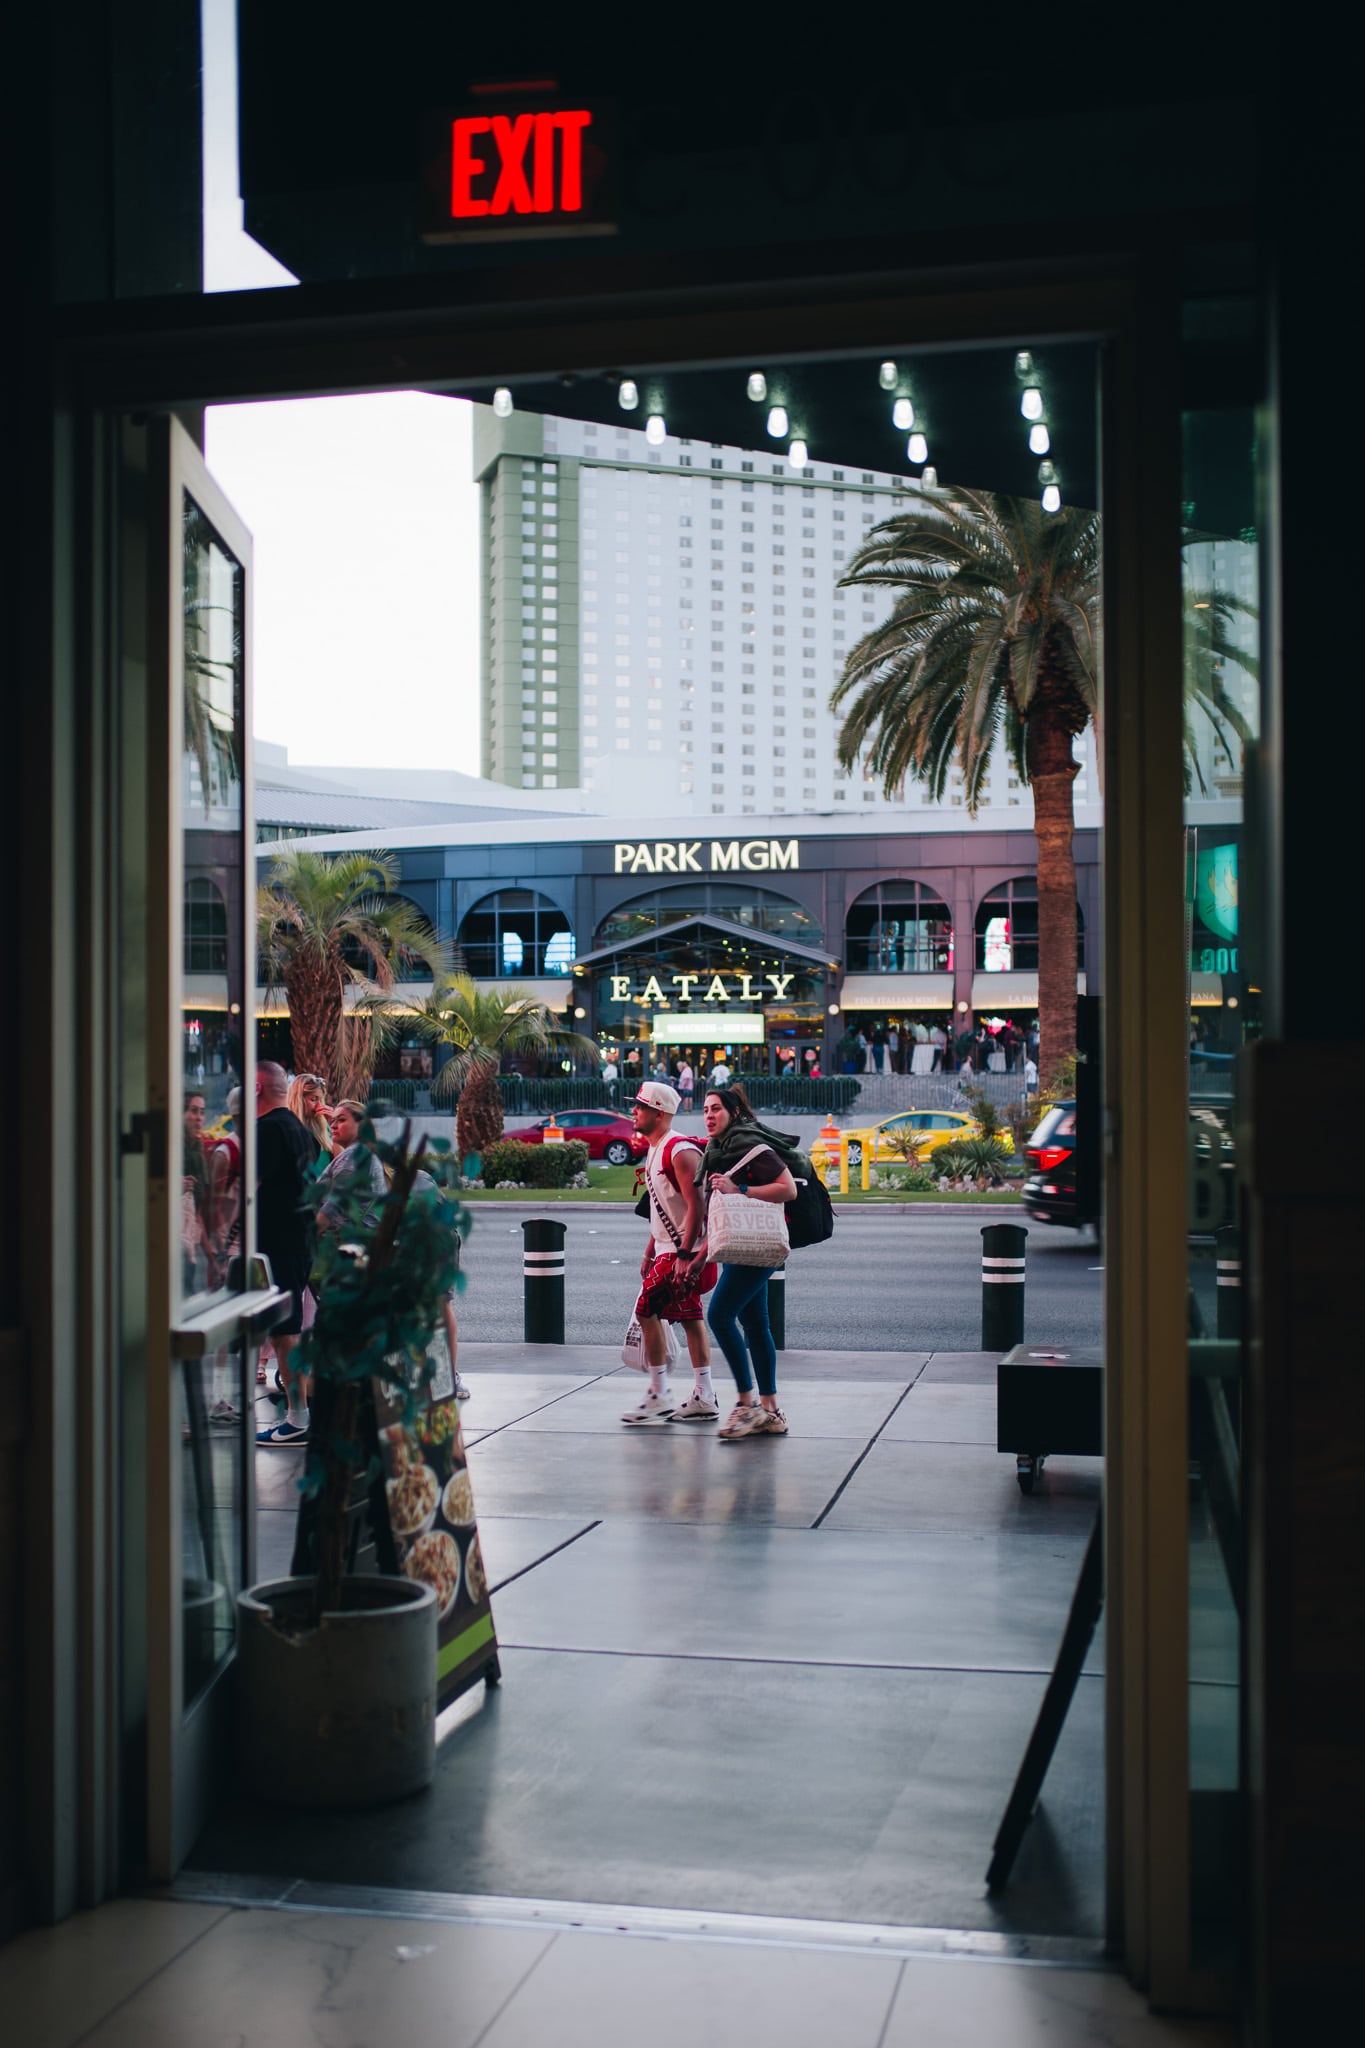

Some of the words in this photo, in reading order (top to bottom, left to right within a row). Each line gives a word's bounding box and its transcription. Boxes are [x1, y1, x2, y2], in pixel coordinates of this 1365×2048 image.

[451, 109, 593, 218] EXIT
[614, 842, 703, 873] PARK
[710, 840, 799, 871] MGM
[610, 974, 795, 1001] EATALY
[714, 1213, 742, 1231] LAS
